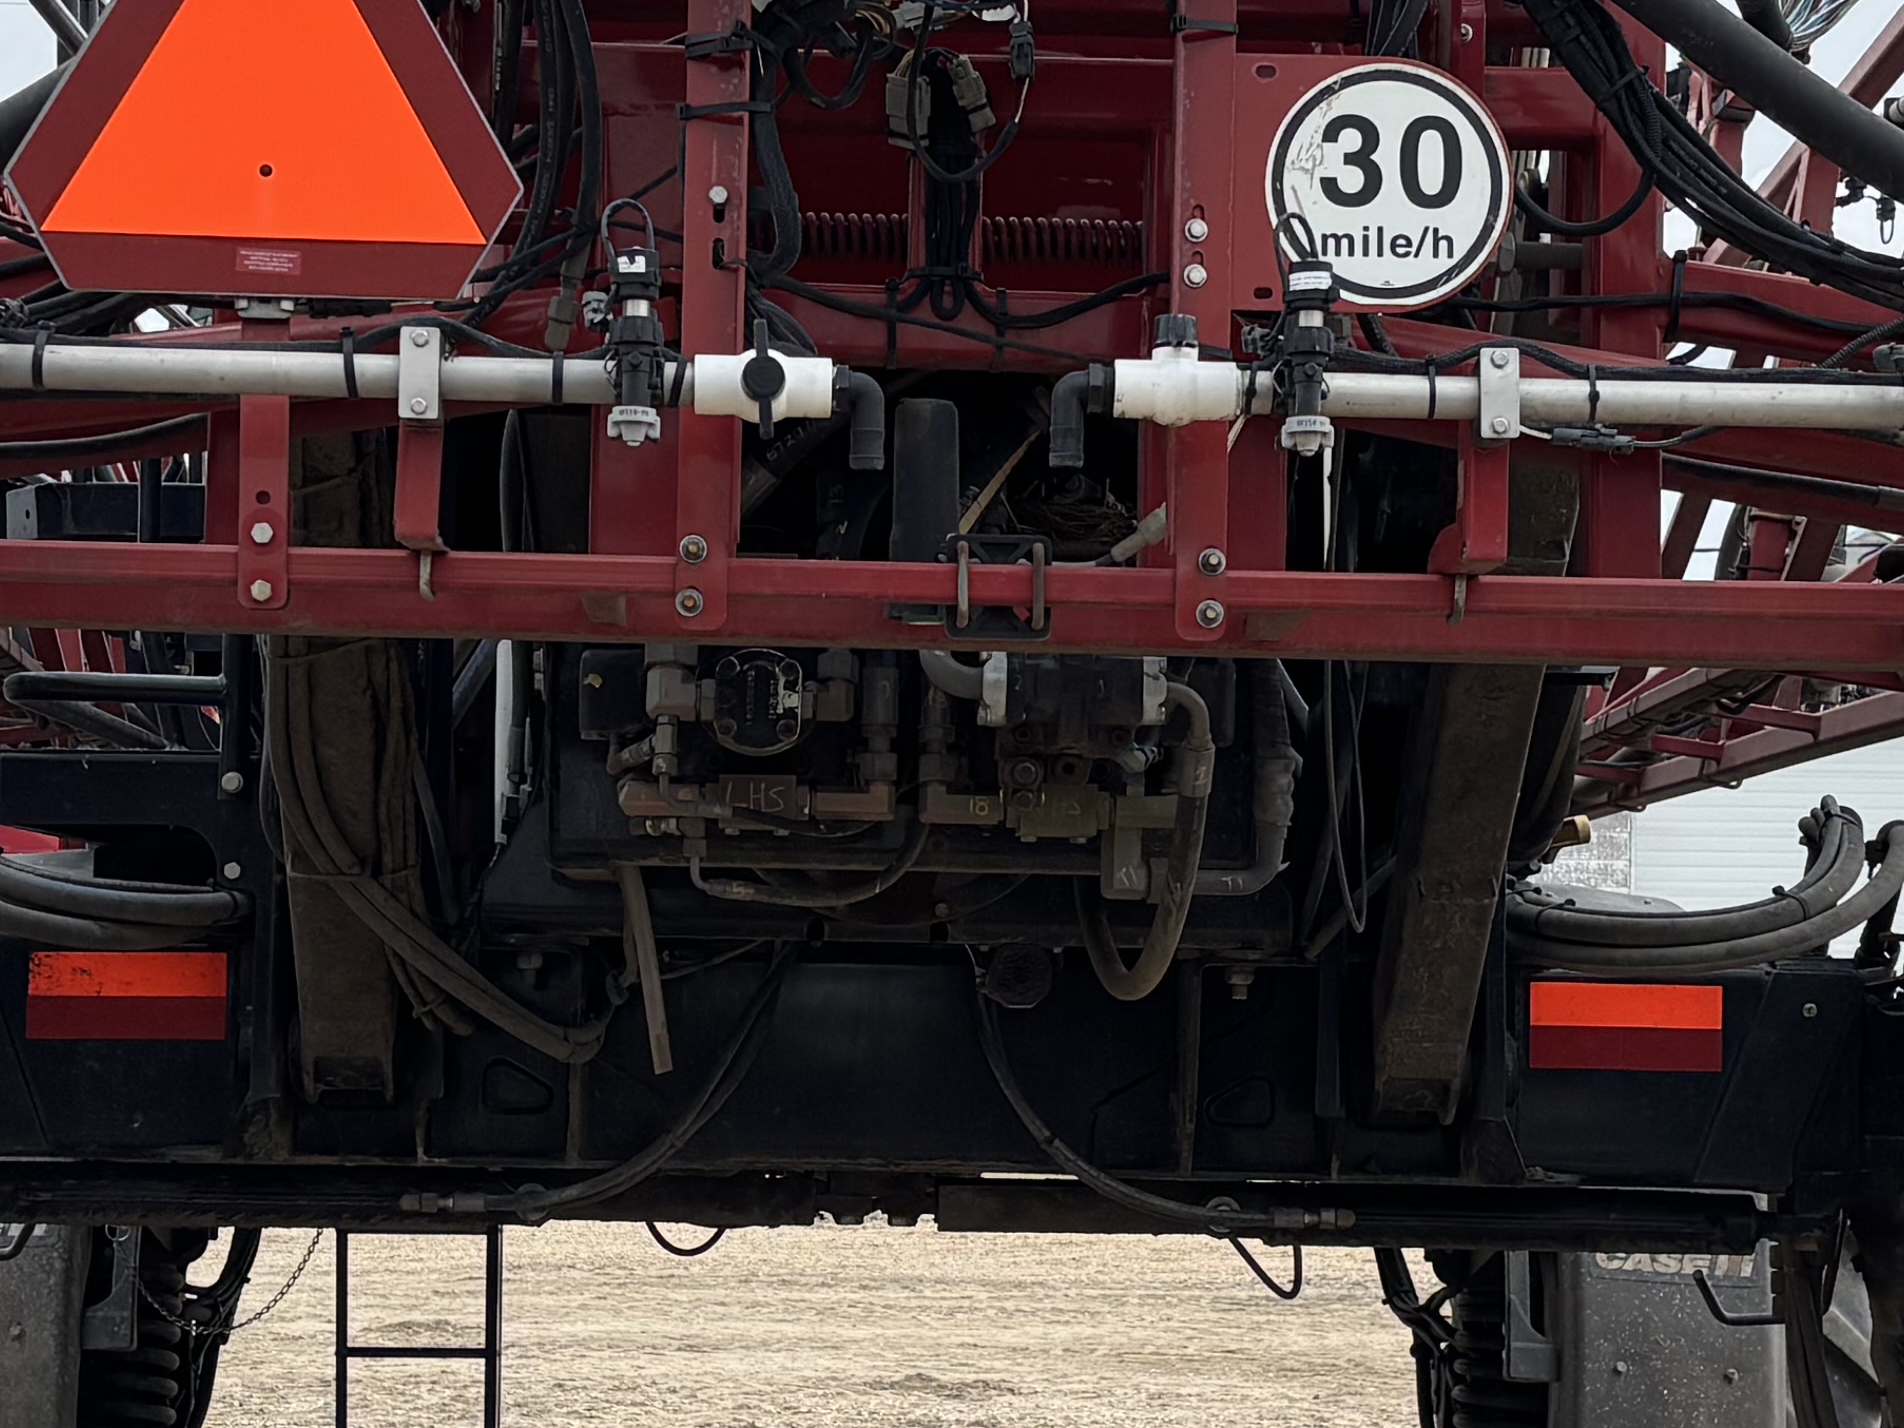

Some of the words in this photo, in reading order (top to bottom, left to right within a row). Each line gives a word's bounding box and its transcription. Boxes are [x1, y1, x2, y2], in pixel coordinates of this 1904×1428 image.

[1319, 113, 1463, 210] 30
[1321, 225, 1455, 259] mile/h
[725, 780, 786, 814] LHS
